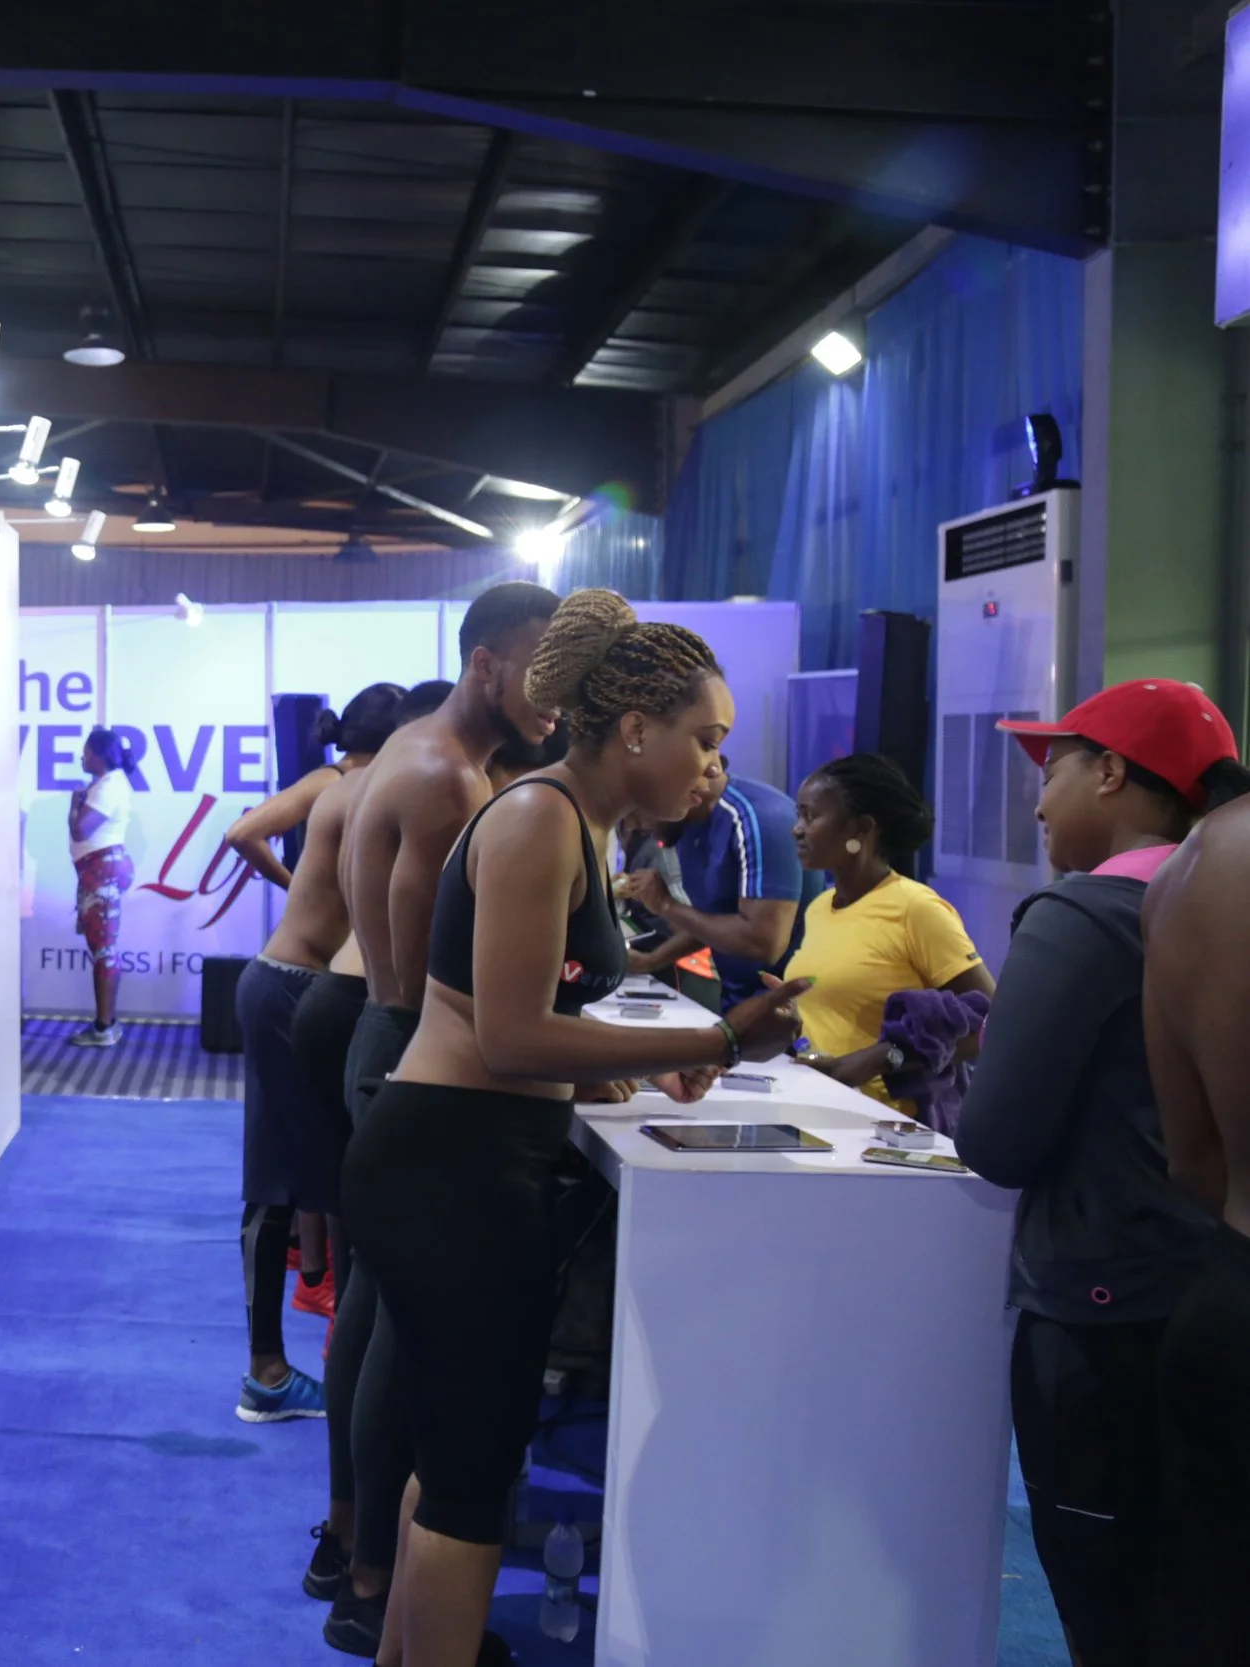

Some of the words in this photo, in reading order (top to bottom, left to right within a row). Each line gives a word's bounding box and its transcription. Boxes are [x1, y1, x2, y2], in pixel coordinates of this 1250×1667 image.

[19, 659, 93, 712] he
[19, 724, 270, 792] ERVE
[41, 948, 151, 973] FITNSS
